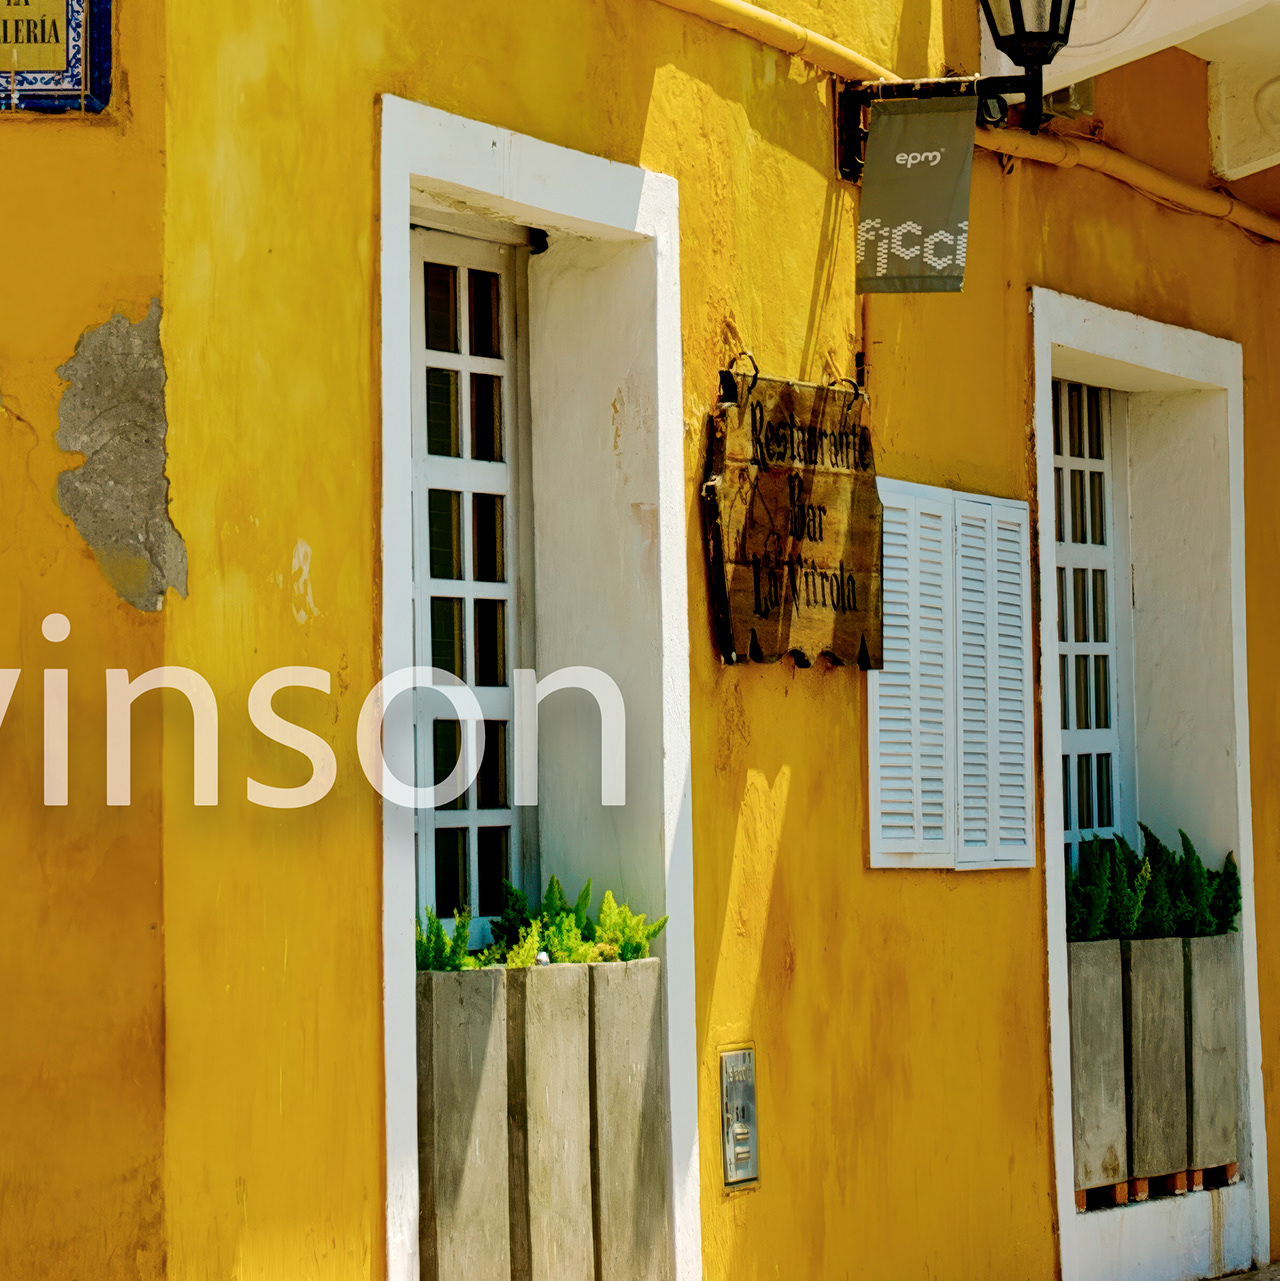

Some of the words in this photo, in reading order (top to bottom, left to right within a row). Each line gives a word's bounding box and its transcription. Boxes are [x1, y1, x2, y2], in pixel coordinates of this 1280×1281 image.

[895, 151, 941, 168] epm
[750, 400, 872, 473] Restaurante
[787, 472, 827, 542] Bar
[752, 552, 779, 619] La
